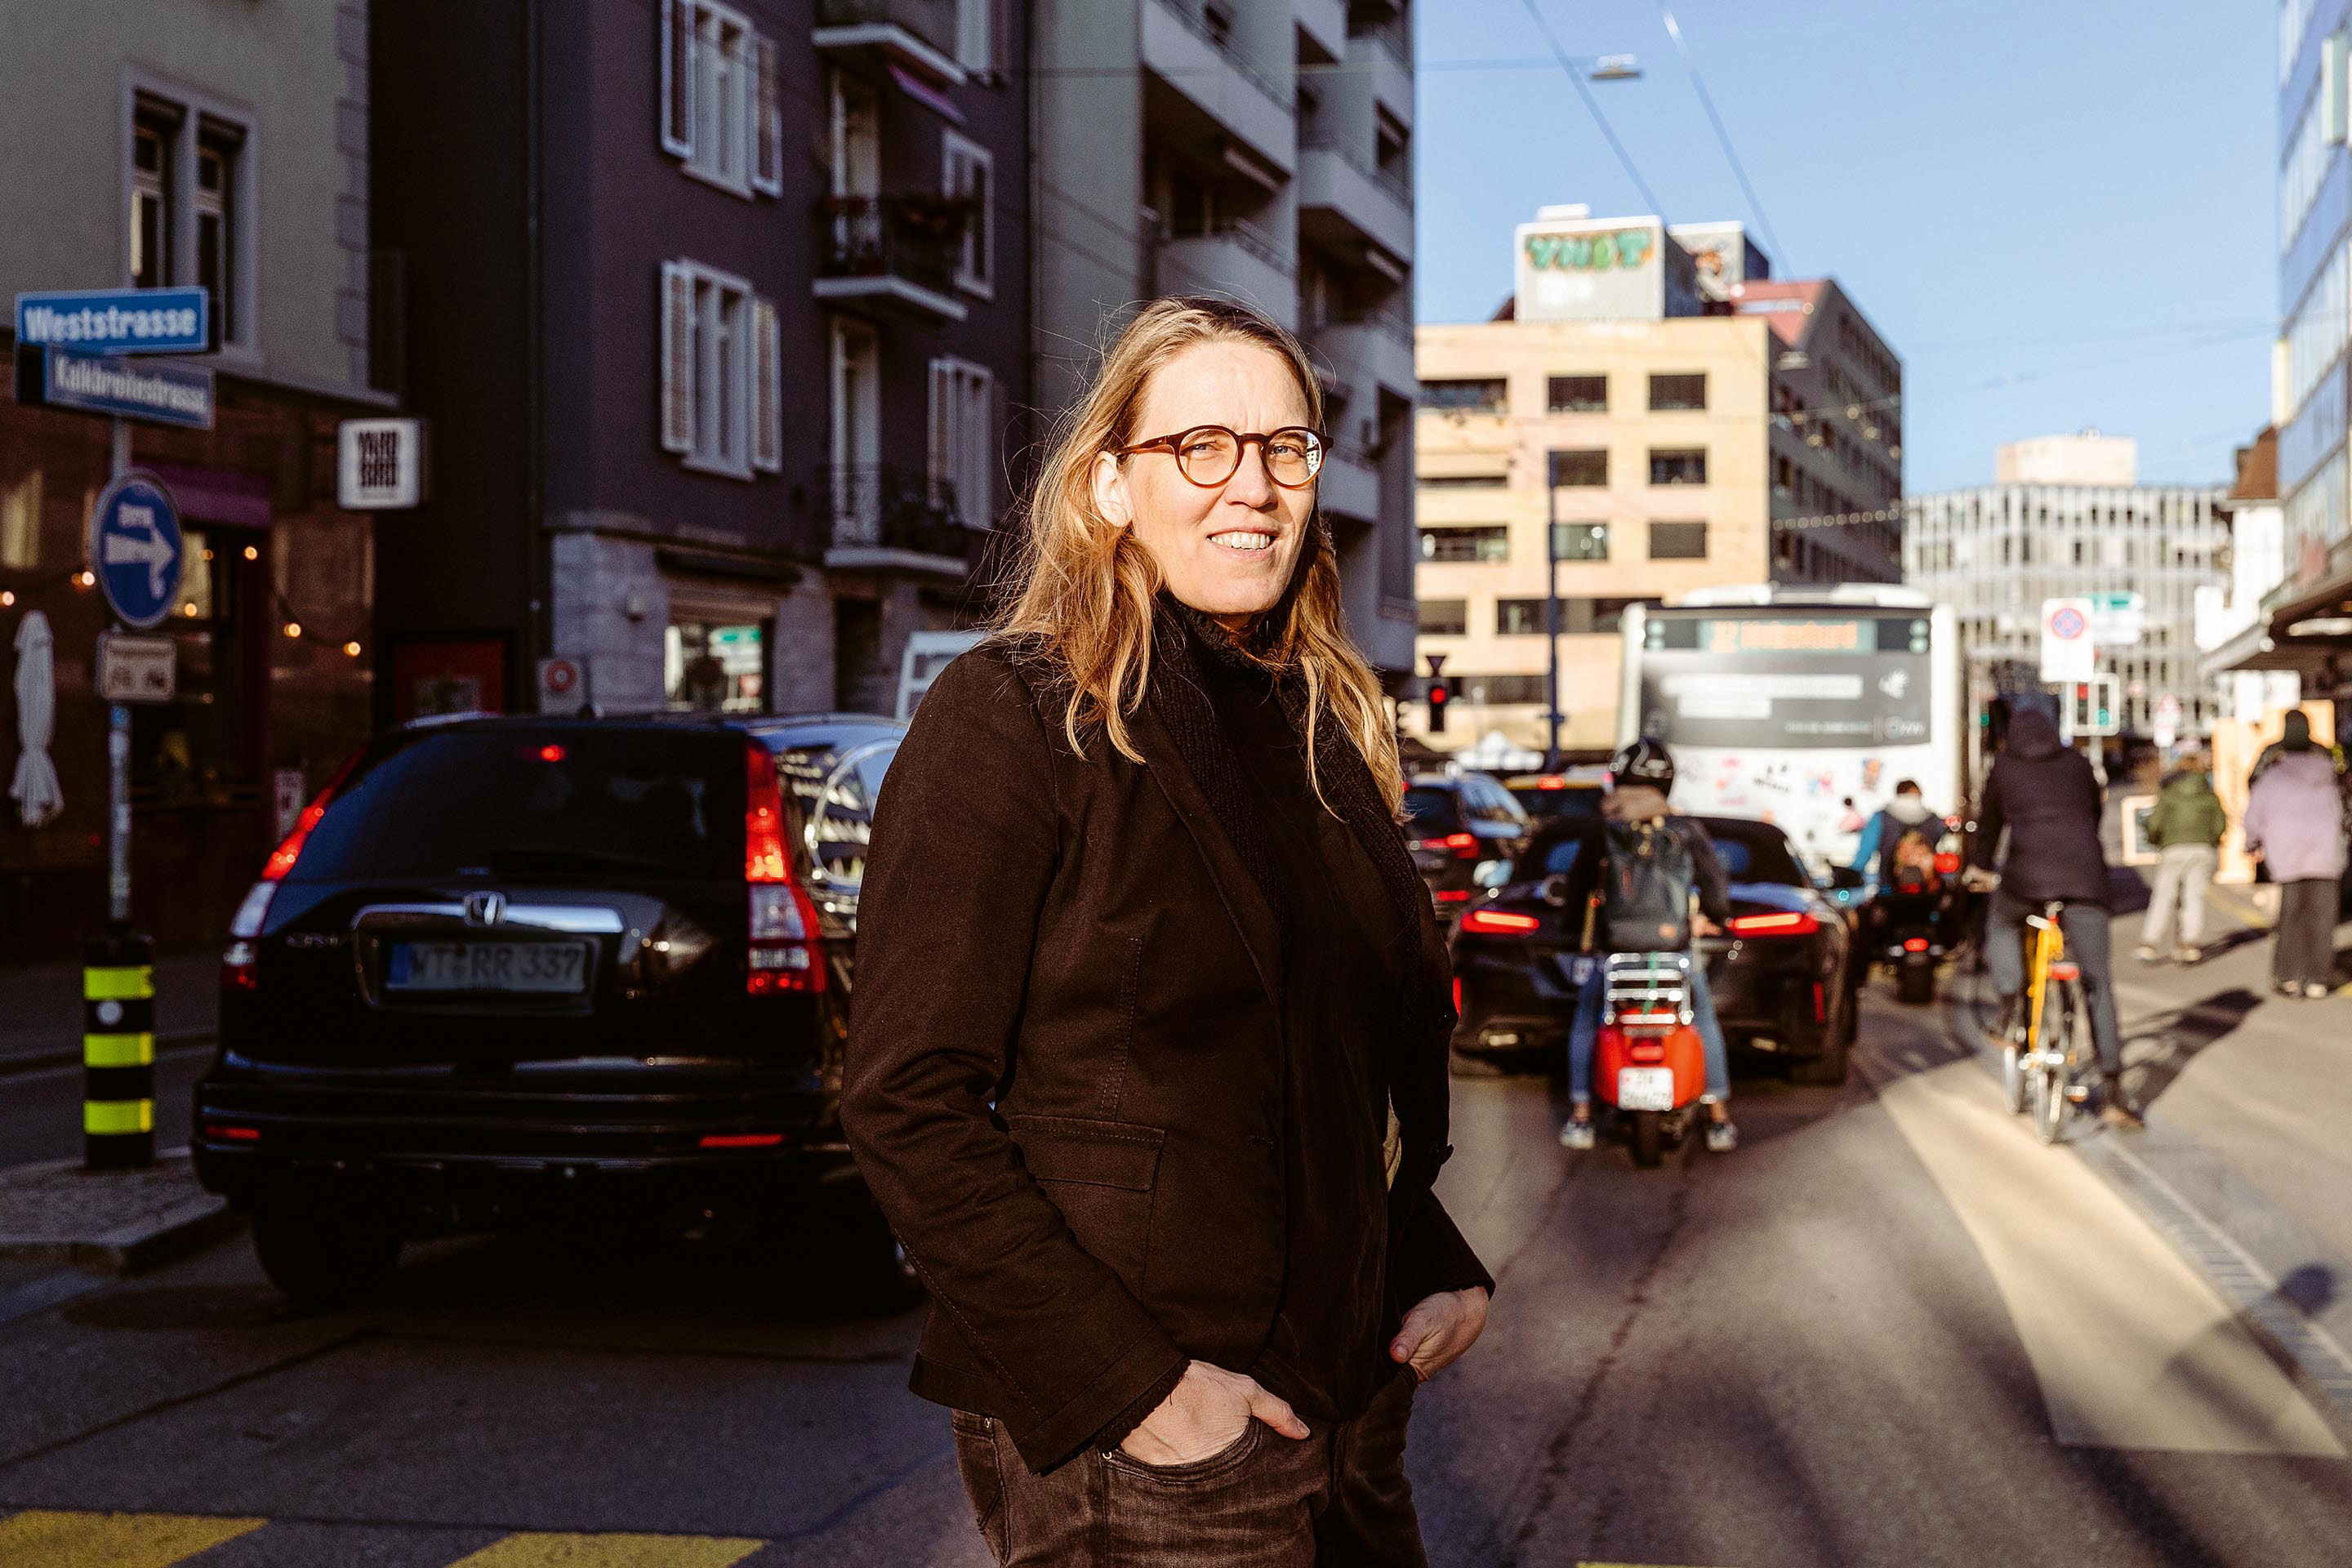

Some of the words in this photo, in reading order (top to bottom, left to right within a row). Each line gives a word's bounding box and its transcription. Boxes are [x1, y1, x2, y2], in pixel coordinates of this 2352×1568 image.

[24, 305, 197, 342] Weststrasse
[470, 947, 513, 978] RR
[522, 947, 581, 979] 337
